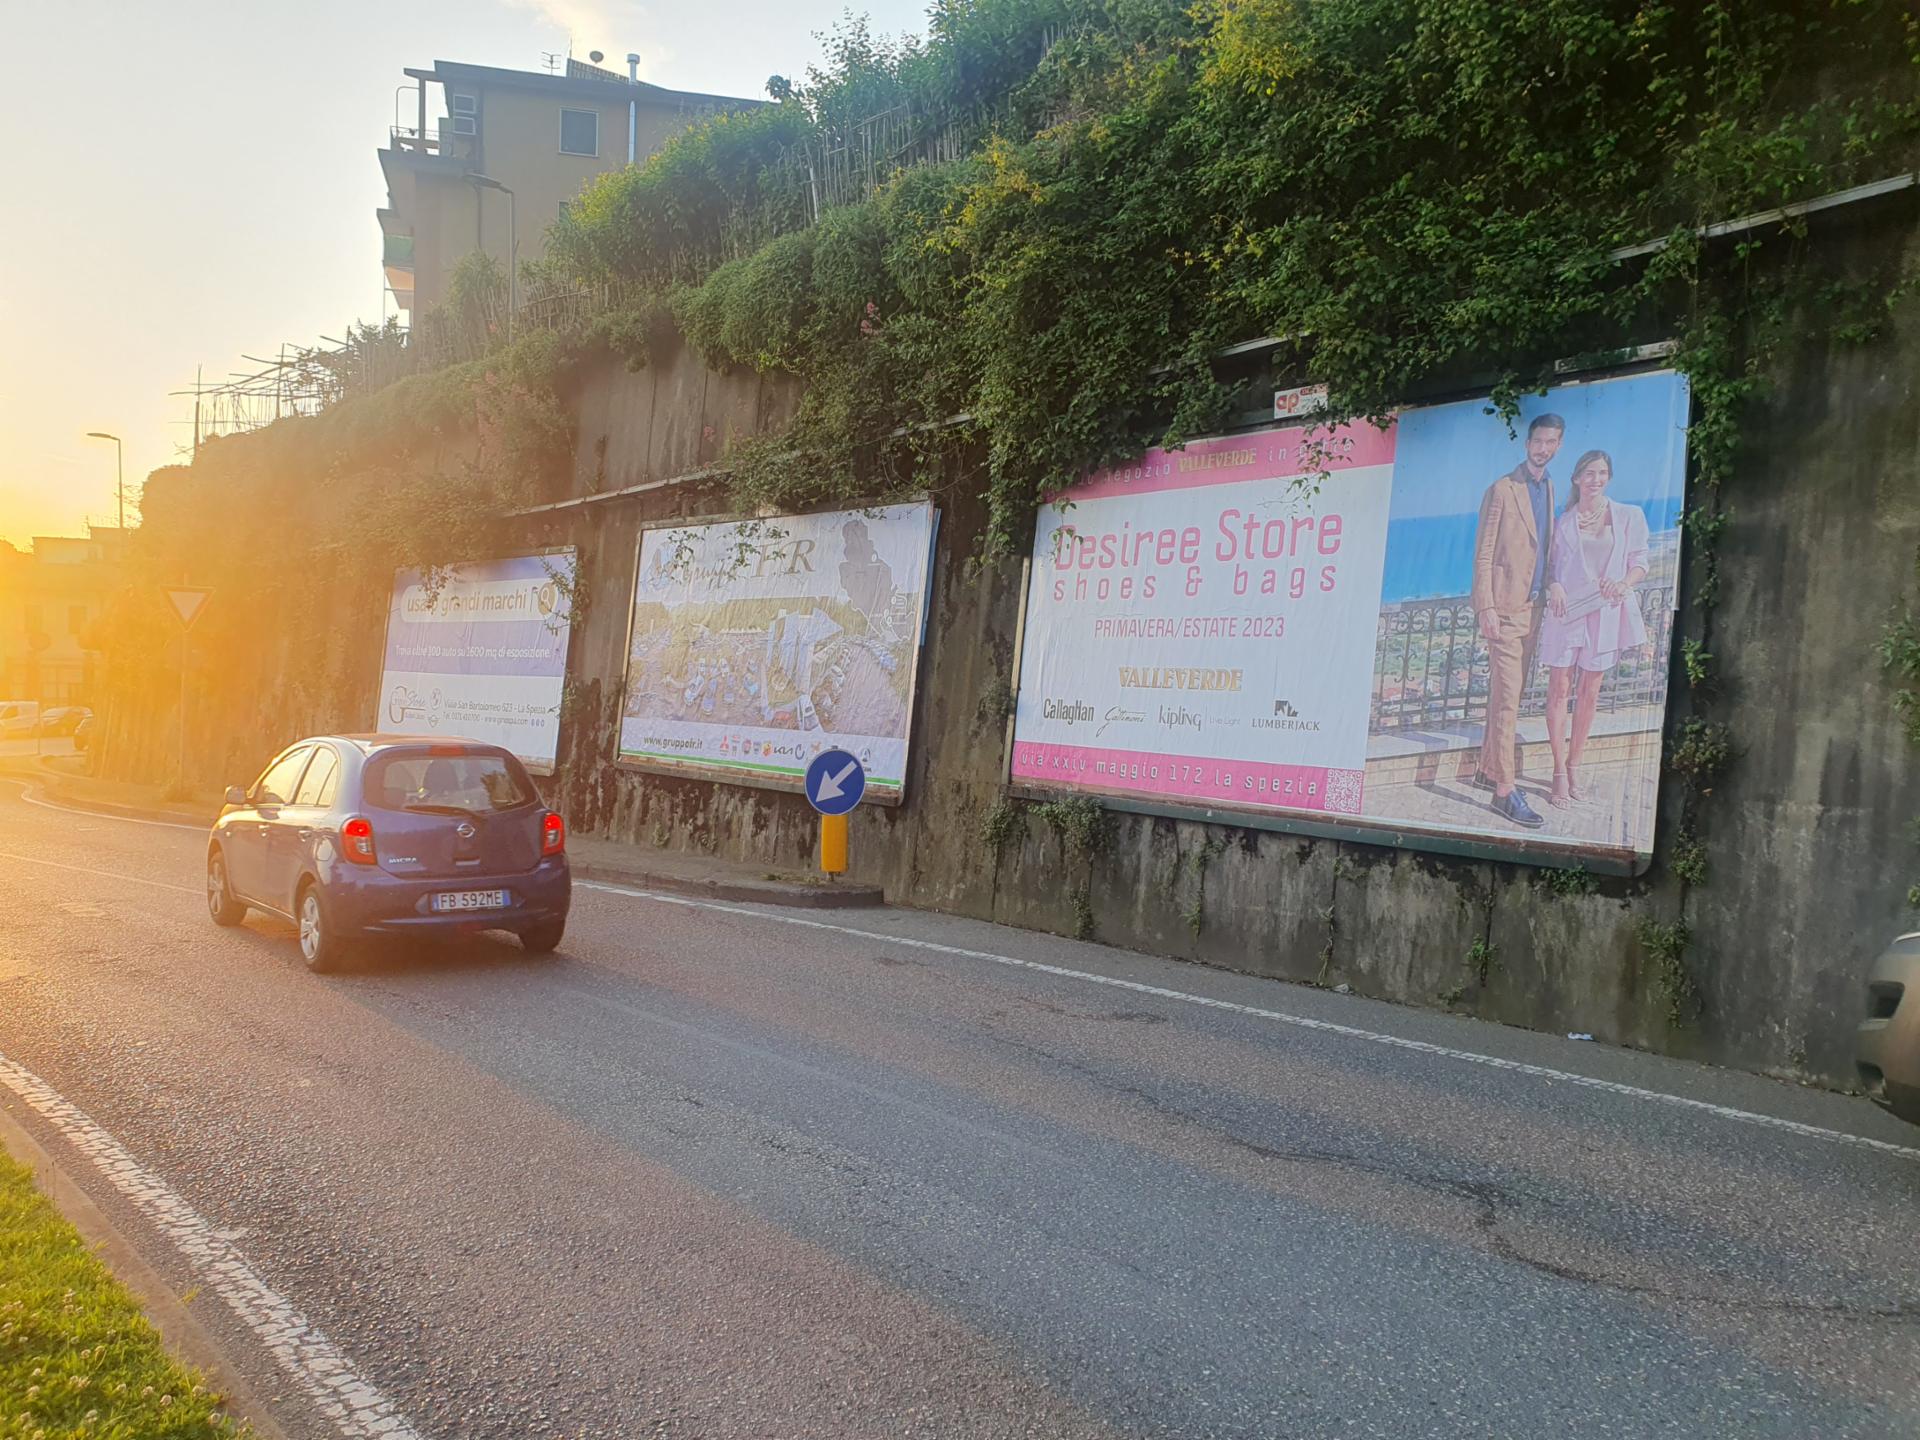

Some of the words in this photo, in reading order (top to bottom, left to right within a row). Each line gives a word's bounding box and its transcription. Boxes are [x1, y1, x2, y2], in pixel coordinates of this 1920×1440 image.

[1055, 521, 1201, 571] Desiree
[1215, 508, 1343, 562] Store
[1053, 572, 1156, 601] shoes
[1185, 565, 1203, 597] &
[1233, 563, 1337, 599] bags
[481, 589, 527, 611] marchi
[1094, 616, 1237, 639] PRIMAVERA/ESTATE
[1243, 616, 1284, 638] 2023
[1118, 666, 1243, 692] VALLEVERDE
[1251, 718, 1321, 732] LUMBERJACK
[1021, 753, 1043, 766] via
[1053, 754, 1086, 771] xxiv
[1096, 760, 1159, 779] maggio
[1170, 764, 1203, 784] 172
[1215, 768, 1232, 786] la
[1244, 775, 1317, 795] spezia
[440, 894, 457, 908] FB
[461, 891, 502, 907] 592ME
